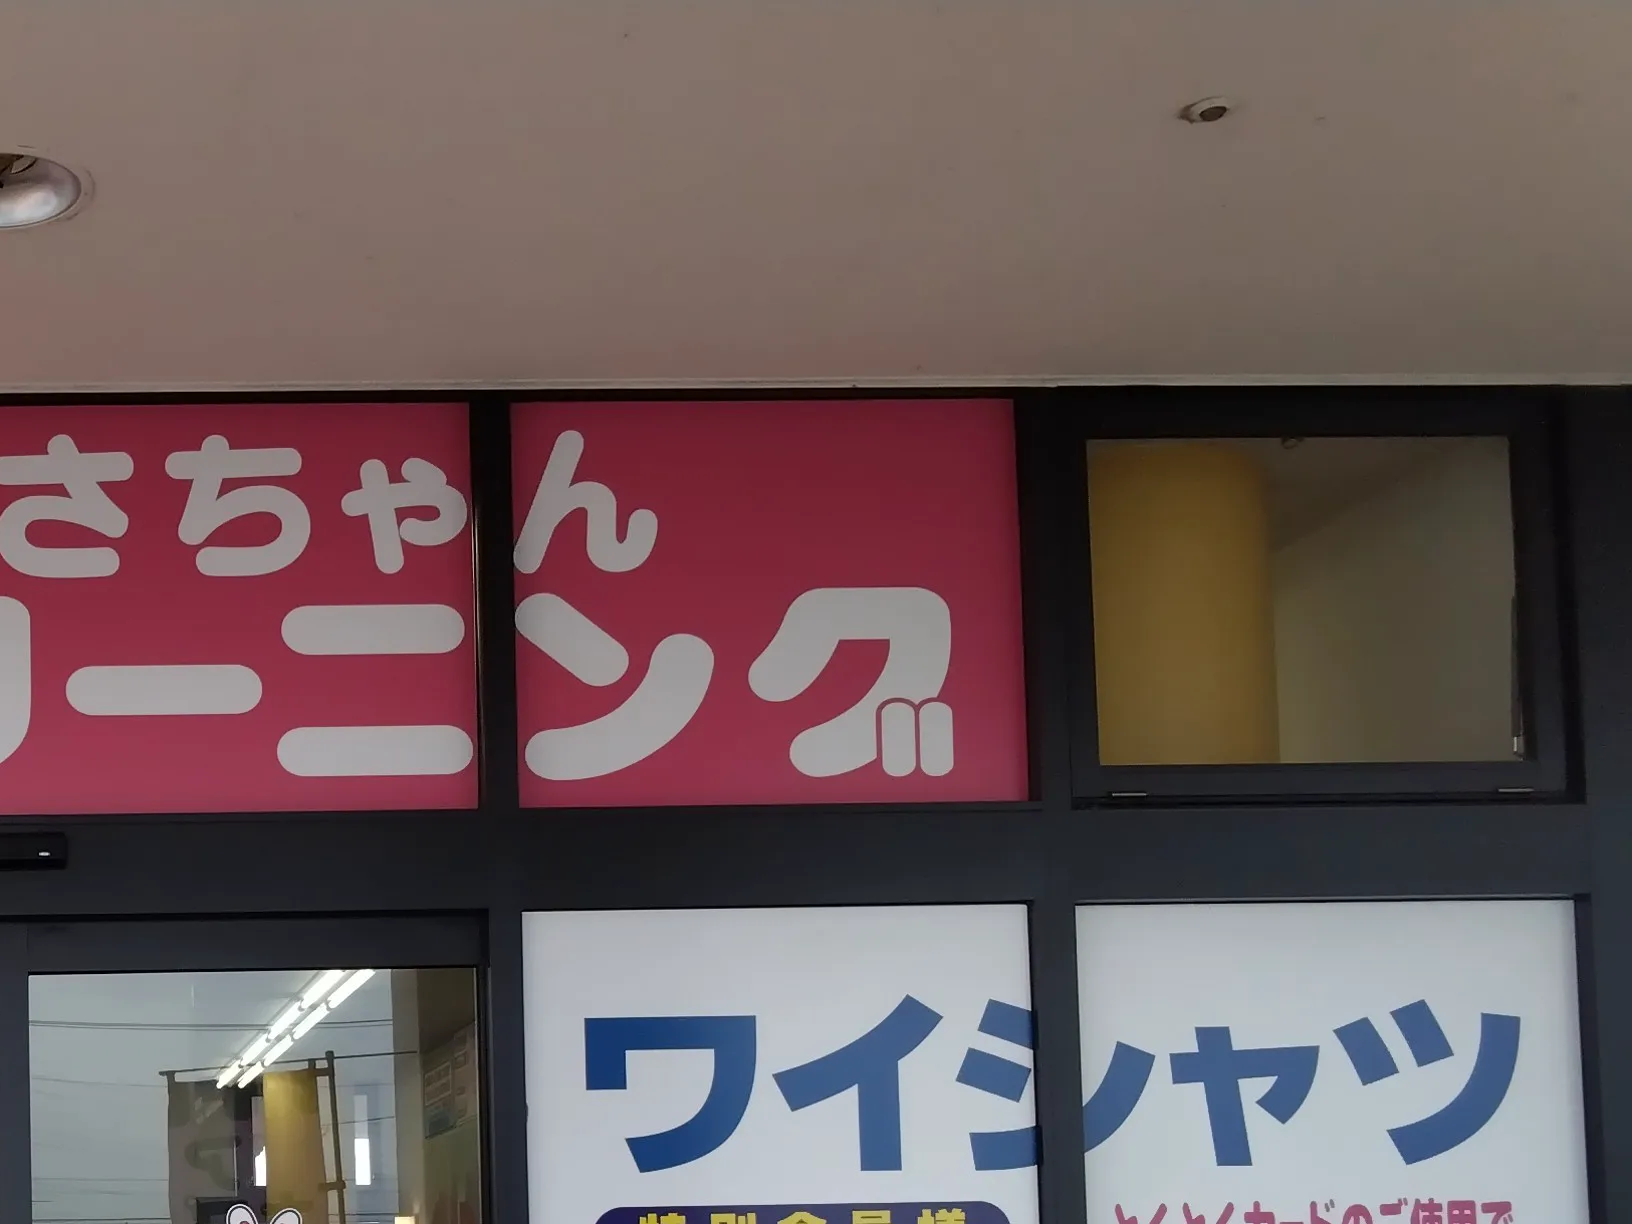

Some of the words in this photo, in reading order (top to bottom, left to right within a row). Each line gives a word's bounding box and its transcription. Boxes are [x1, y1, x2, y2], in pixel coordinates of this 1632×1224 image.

[584, 994, 1521, 1173] ワイシャツ
